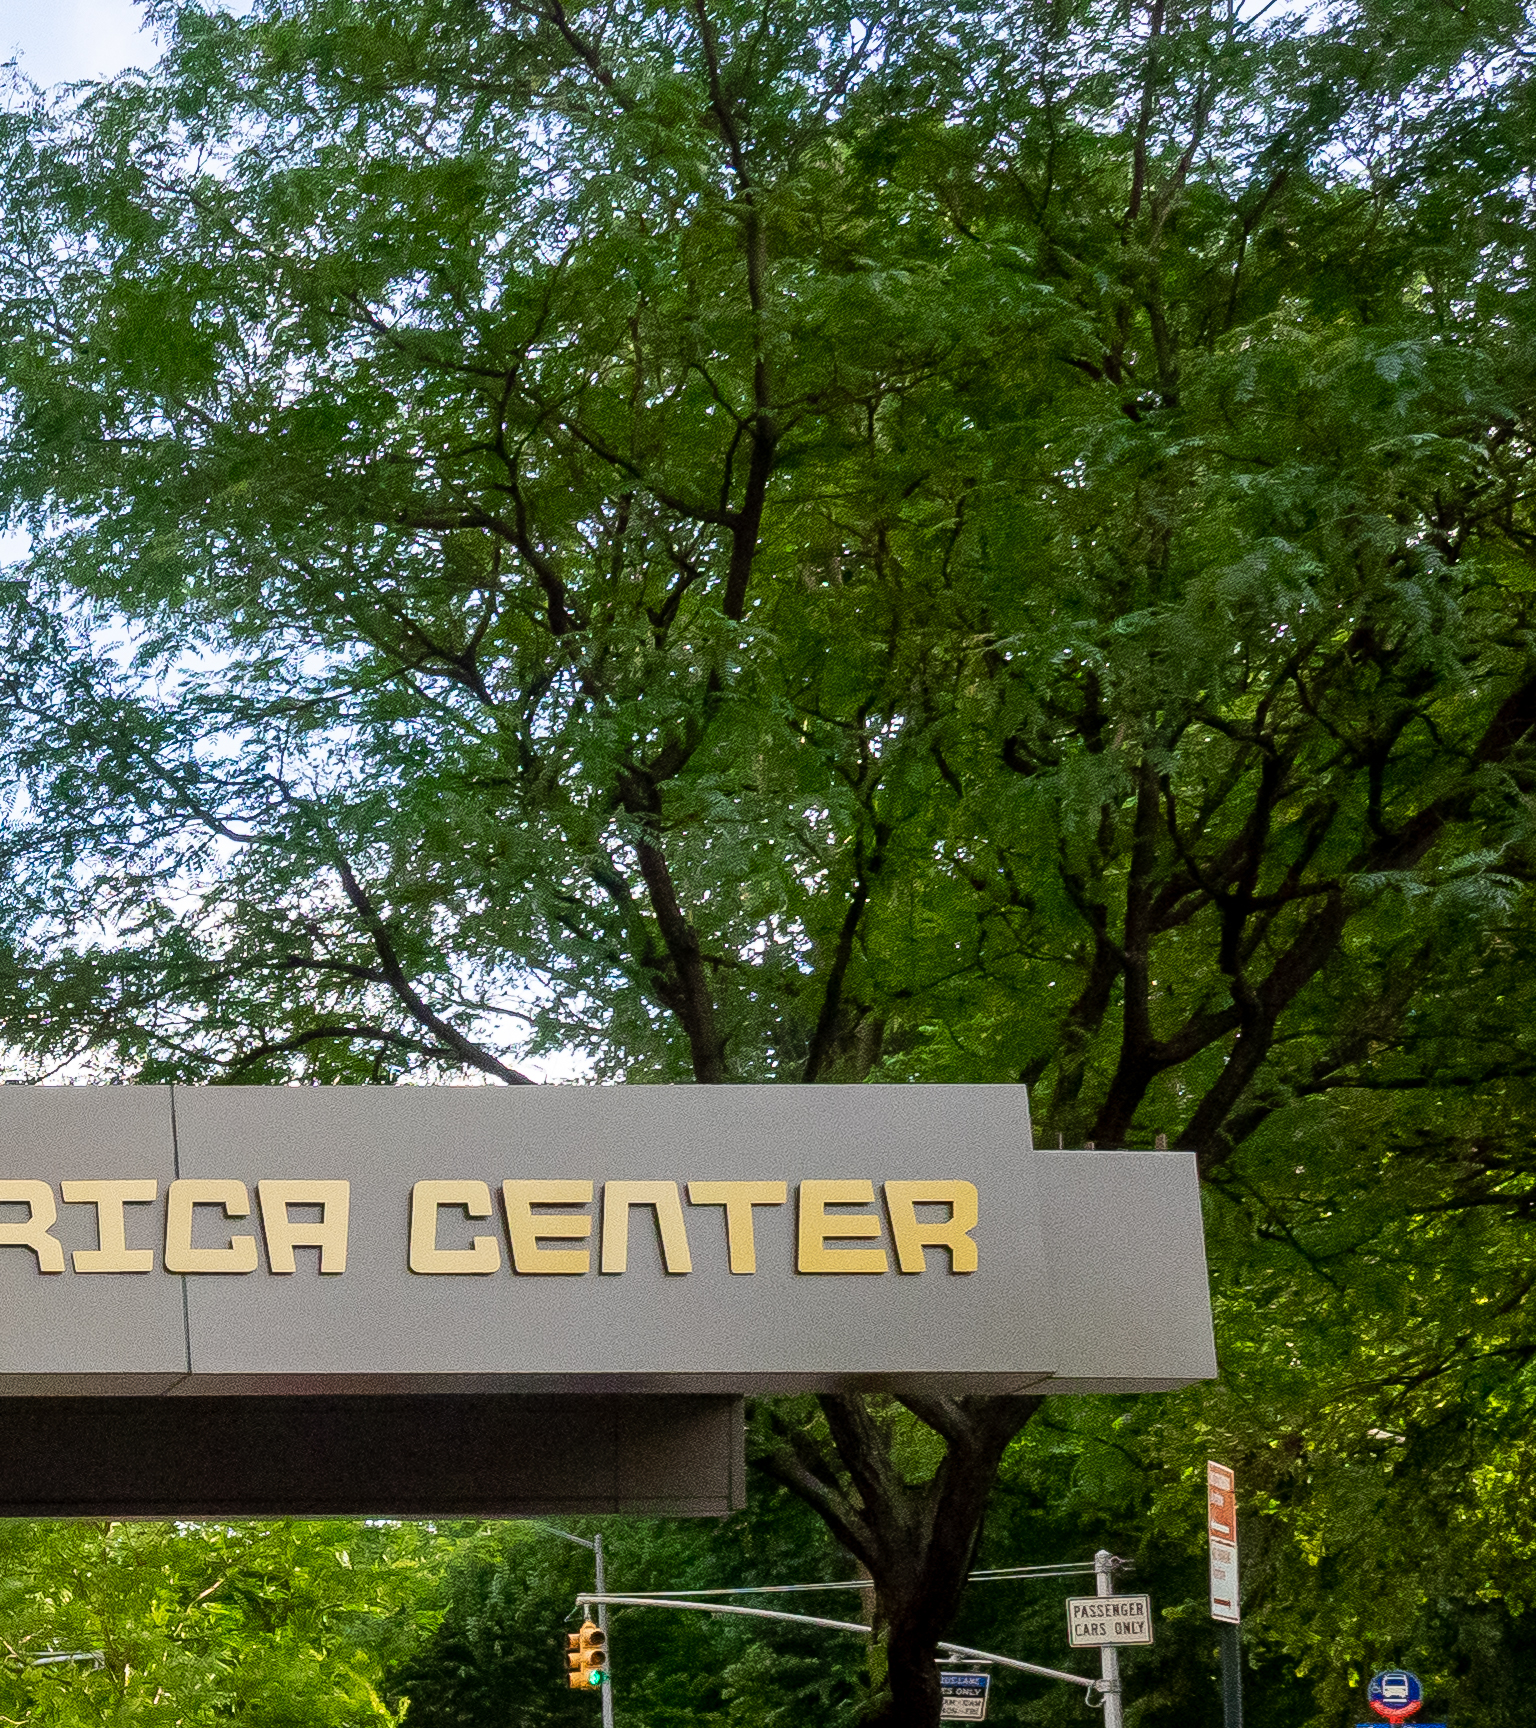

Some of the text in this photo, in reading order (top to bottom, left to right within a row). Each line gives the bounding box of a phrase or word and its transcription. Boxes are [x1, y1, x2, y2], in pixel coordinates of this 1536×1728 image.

[409, 1179, 979, 1274] CENTER
[1073, 1603, 1144, 1619] PASSENGER
[1075, 1621, 1145, 1637] CARS ONLY
